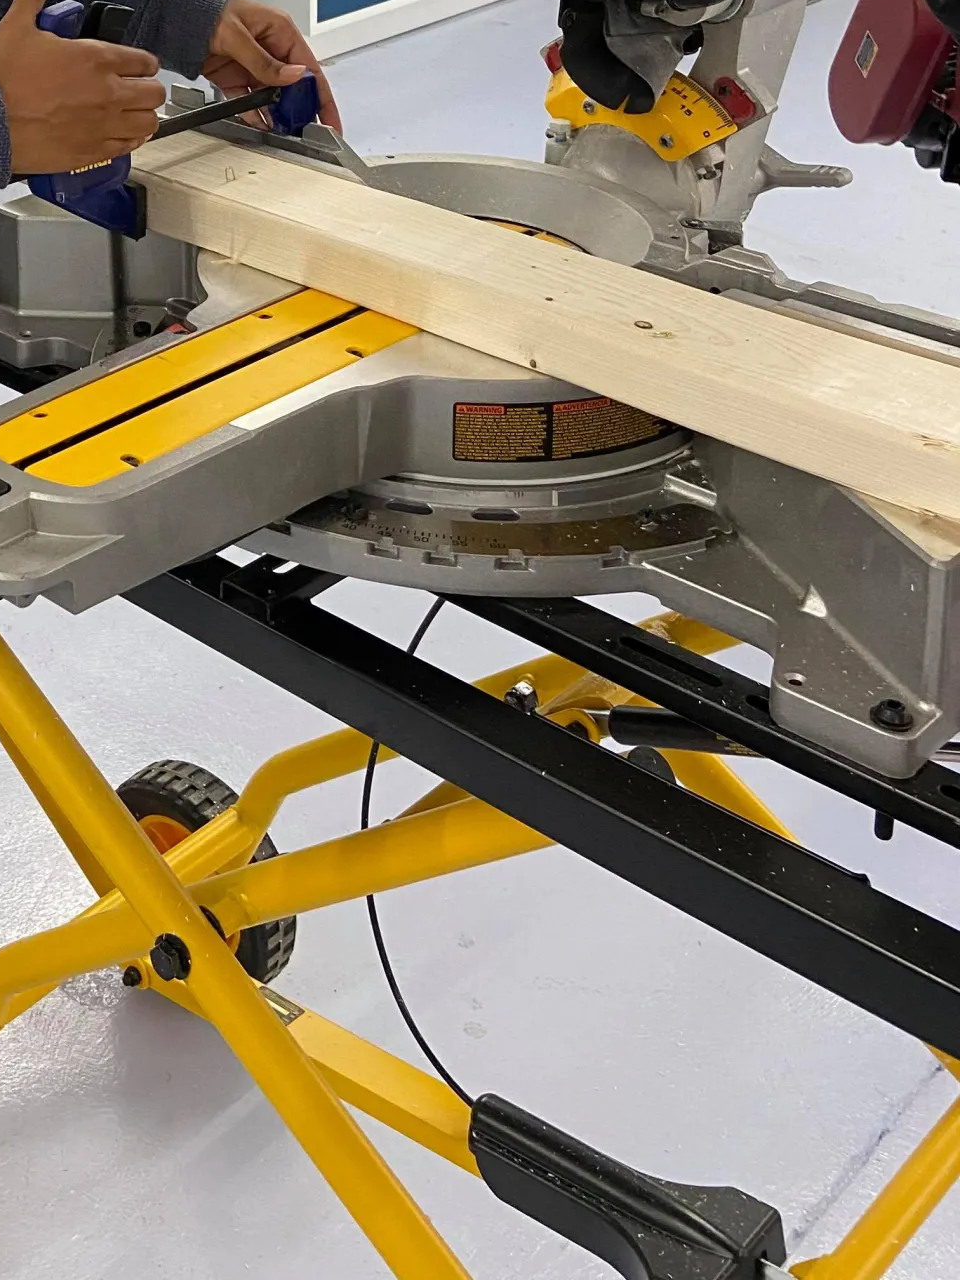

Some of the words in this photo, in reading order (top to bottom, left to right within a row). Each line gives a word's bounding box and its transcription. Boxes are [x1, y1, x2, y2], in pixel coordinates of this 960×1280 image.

[680, 104, 693, 116] 15
[465, 406, 503, 415] WARNING
[562, 400, 608, 411] ADVERTENCIA
[342, 523, 357, 531] 40
